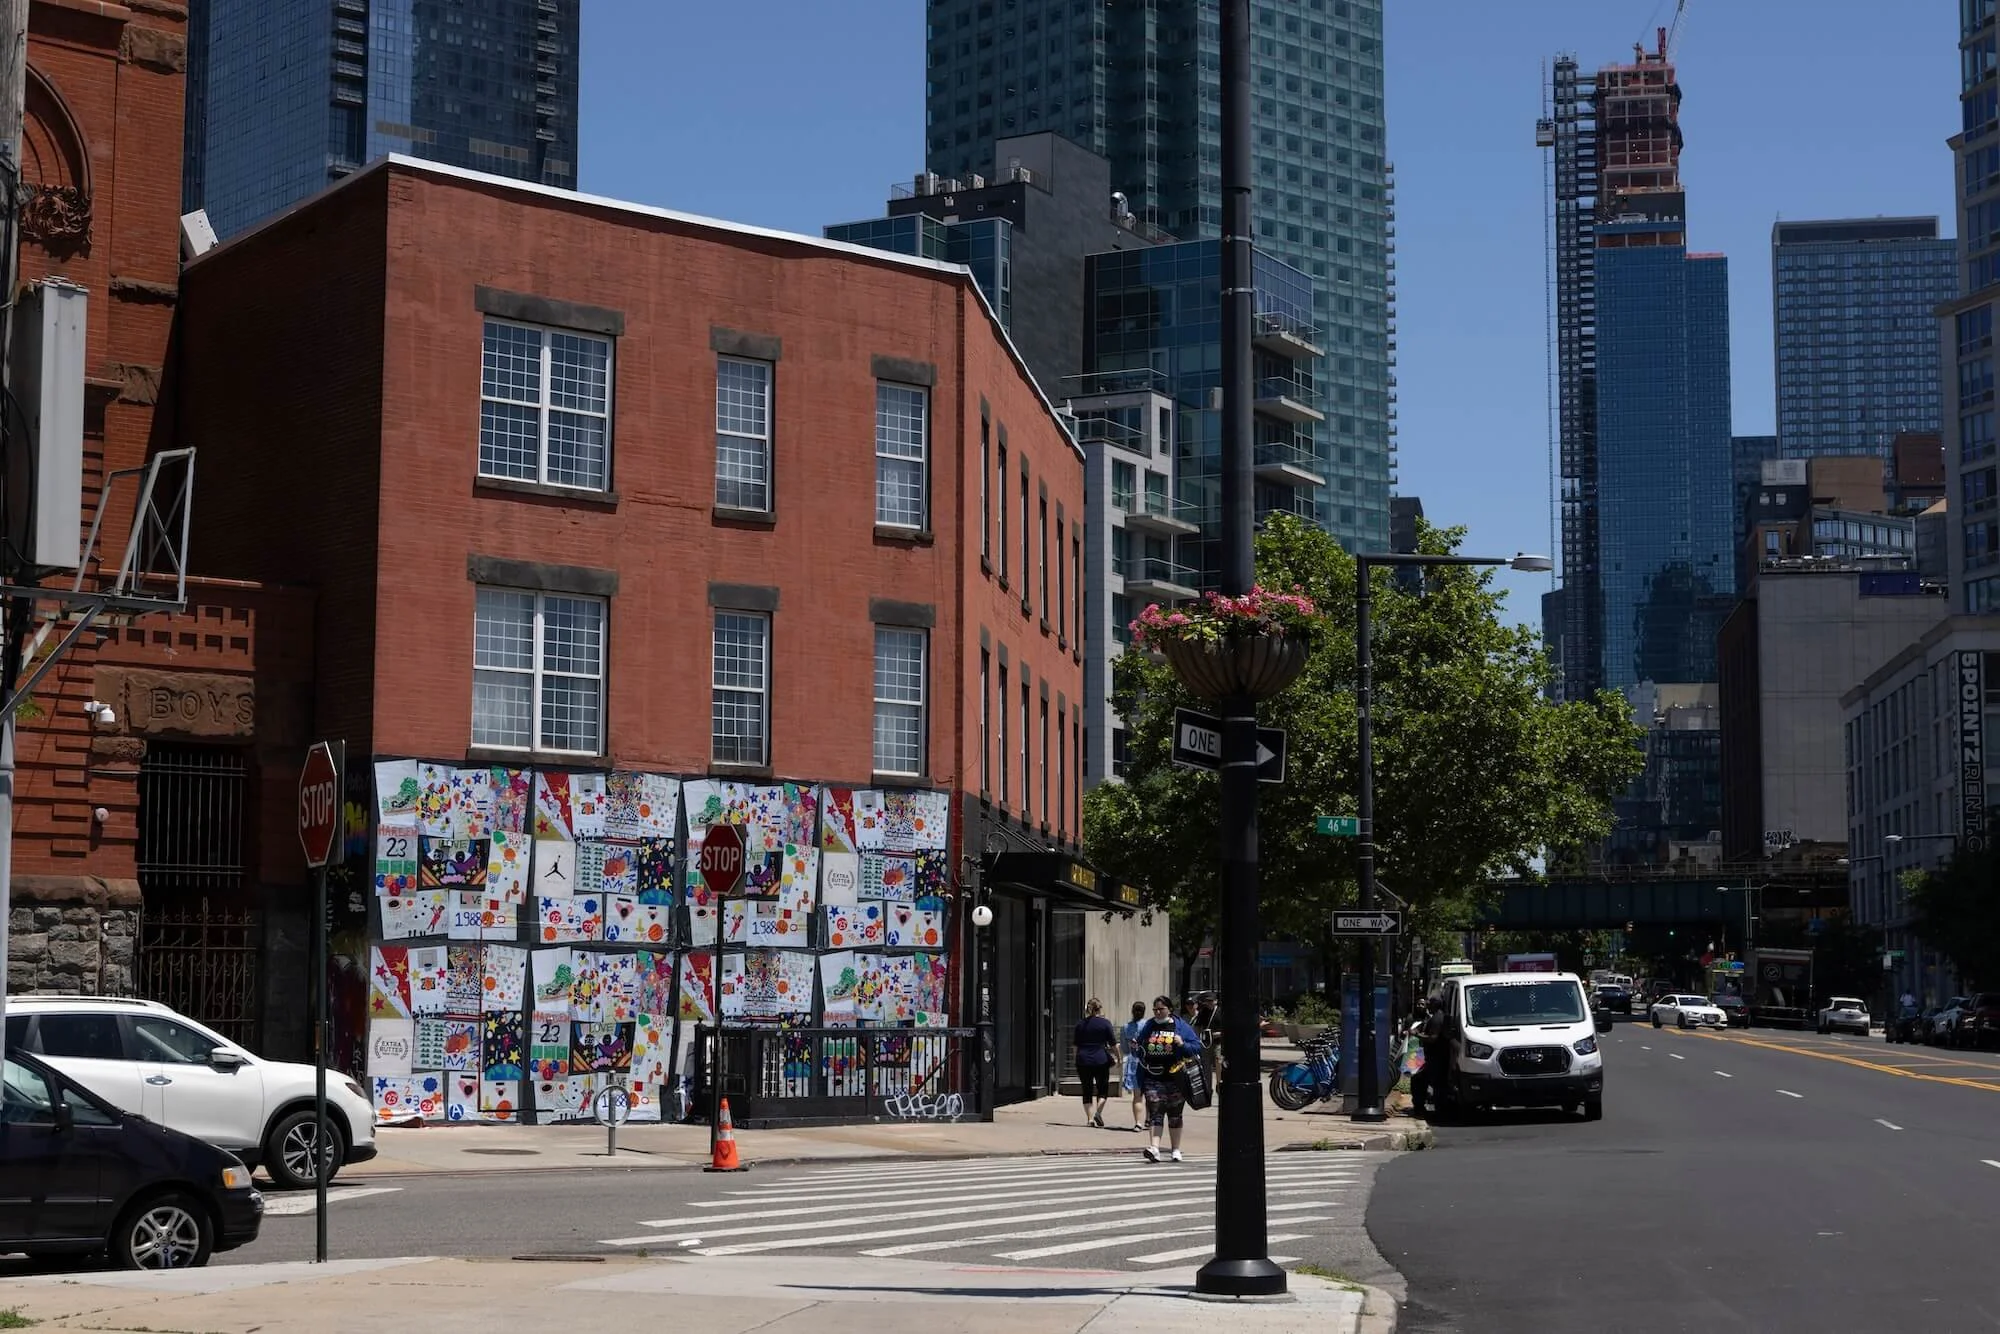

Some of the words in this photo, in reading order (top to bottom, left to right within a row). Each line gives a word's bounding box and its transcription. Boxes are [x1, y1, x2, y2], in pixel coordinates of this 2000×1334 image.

[151, 687, 254, 724] BOYS
[1189, 728, 1215, 754] ONE
[302, 781, 333, 829] STOP
[1327, 818, 1339, 833] 46
[387, 837, 408, 858] 23
[702, 846, 741, 872] STOP
[455, 911, 482, 927] 1988
[752, 919, 778, 935] 1988
[1342, 918, 1361, 928] ONE
[1370, 918, 1390, 928] WAY
[540, 1023, 560, 1043] 23
[602, 1092, 629, 1108] 188
